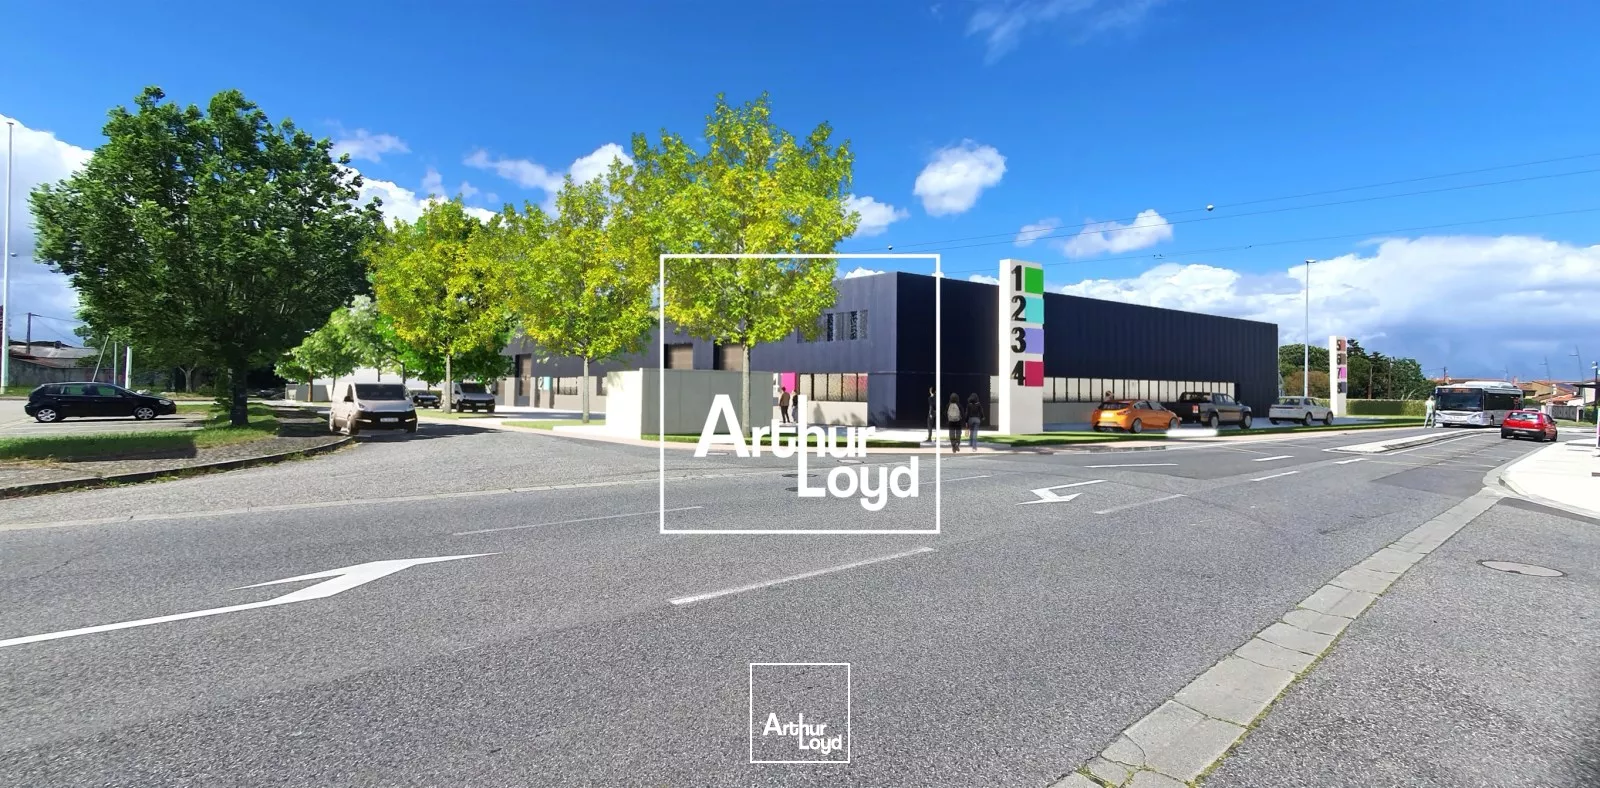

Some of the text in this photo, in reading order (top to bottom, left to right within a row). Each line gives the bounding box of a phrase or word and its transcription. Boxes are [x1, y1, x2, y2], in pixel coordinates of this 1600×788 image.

[1011, 265, 1022, 291] 1
[1011, 295, 1026, 321] 2
[1011, 327, 1026, 353] 3
[1011, 360, 1025, 386] 4
